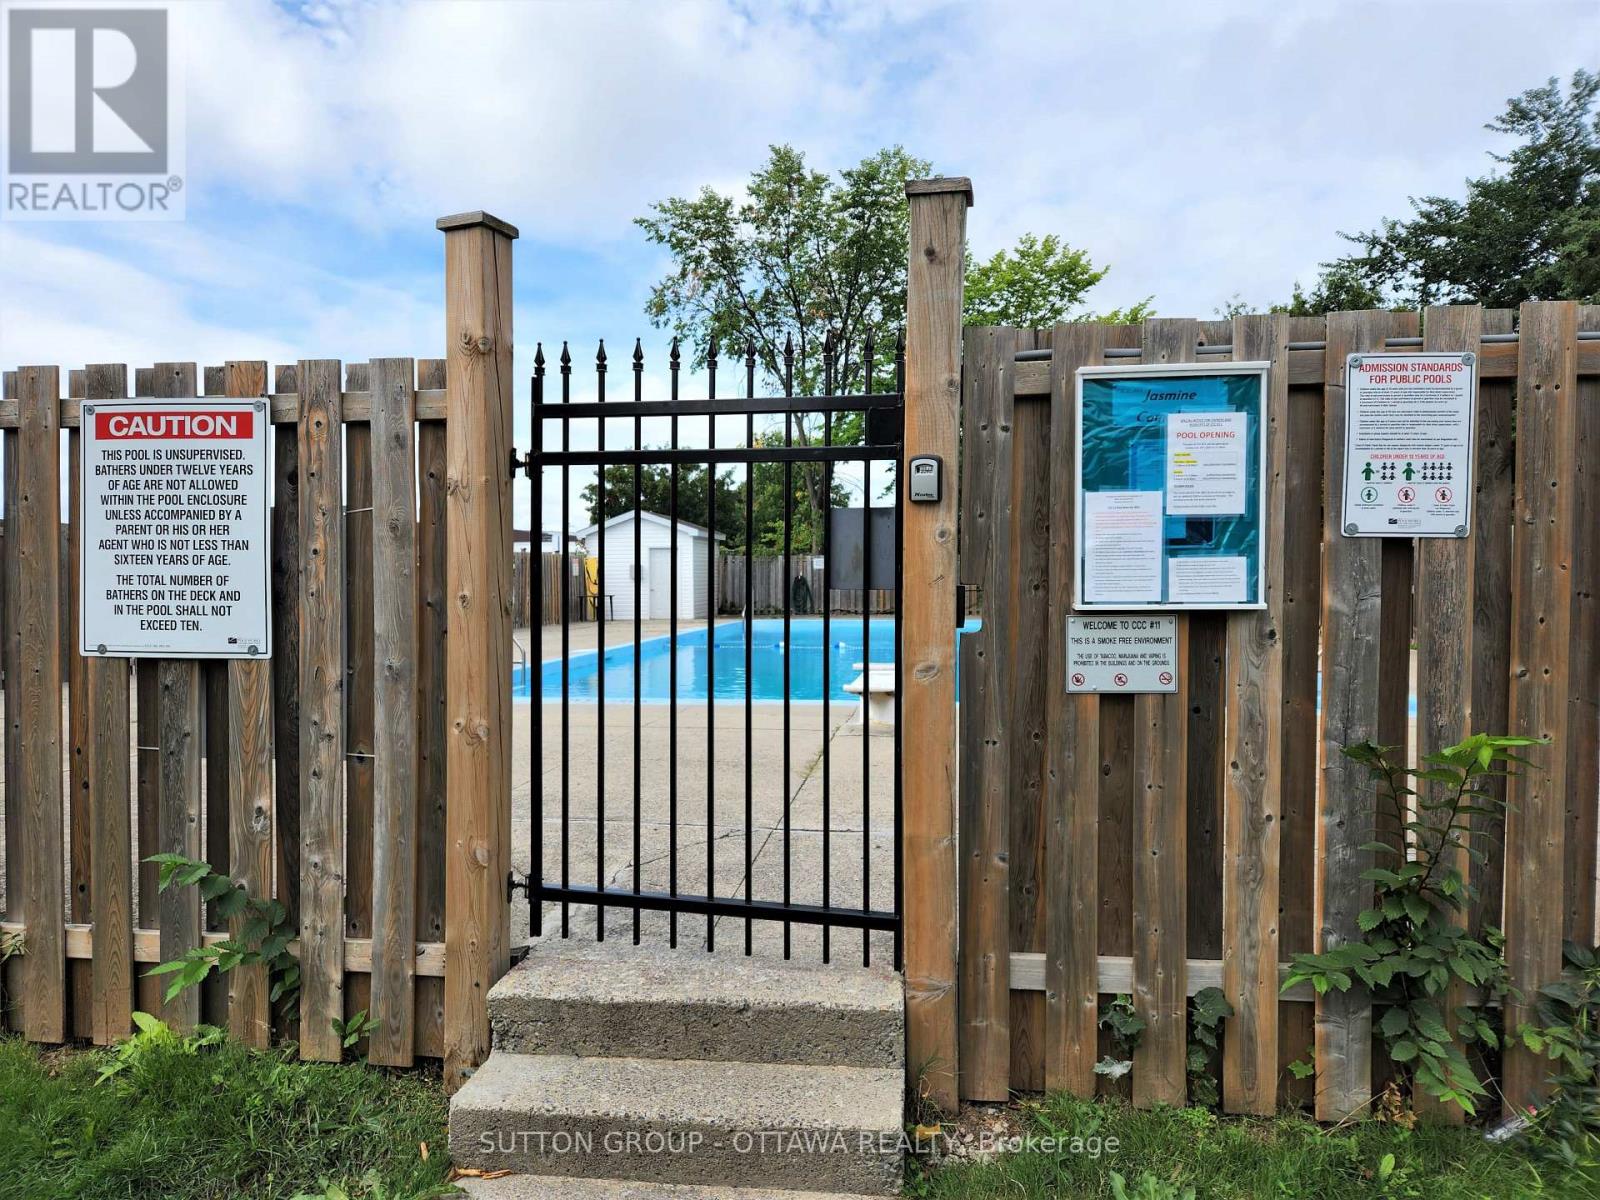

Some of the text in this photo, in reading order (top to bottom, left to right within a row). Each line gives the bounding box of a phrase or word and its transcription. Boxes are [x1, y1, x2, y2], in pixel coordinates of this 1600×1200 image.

[1359, 363, 1463, 372] ADMISSION STANDARDS
[1370, 375, 1452, 384] FOR PUBLIC POOLS
[1143, 389, 1197, 402] Jasmine
[109, 415, 237, 436] CAUTION
[102, 450, 245, 460] THIS POOL IS UNSUPERVISED.
[96, 465, 253, 475] BATHERS UNDER TWELVE YEARS
[108, 480, 238, 490] OF AGE ARE NOT ALLOWED
[100, 495, 247, 505] WITHIN THE POOL ENCLOSURE
[105, 510, 242, 520] UNLESS ACCOMPANIED BY A
[116, 525, 230, 535] PARENT OR HIS OR HER
[99, 540, 249, 550] AGENT WHO IS NOT LESS THAN
[114, 555, 231, 566] SIXTEEN YEARS OF AGE.
[117, 575, 229, 586] THE TOTAL NUMBER OF
[106, 590, 241, 601] BATHERS ON THE DECK AND
[114, 605, 232, 616] IN THE POOL SHALL NOT
[141, 620, 202, 631] EXCEED TEN.
[1083, 621, 1161, 630] WELCOME TO CCC #11
